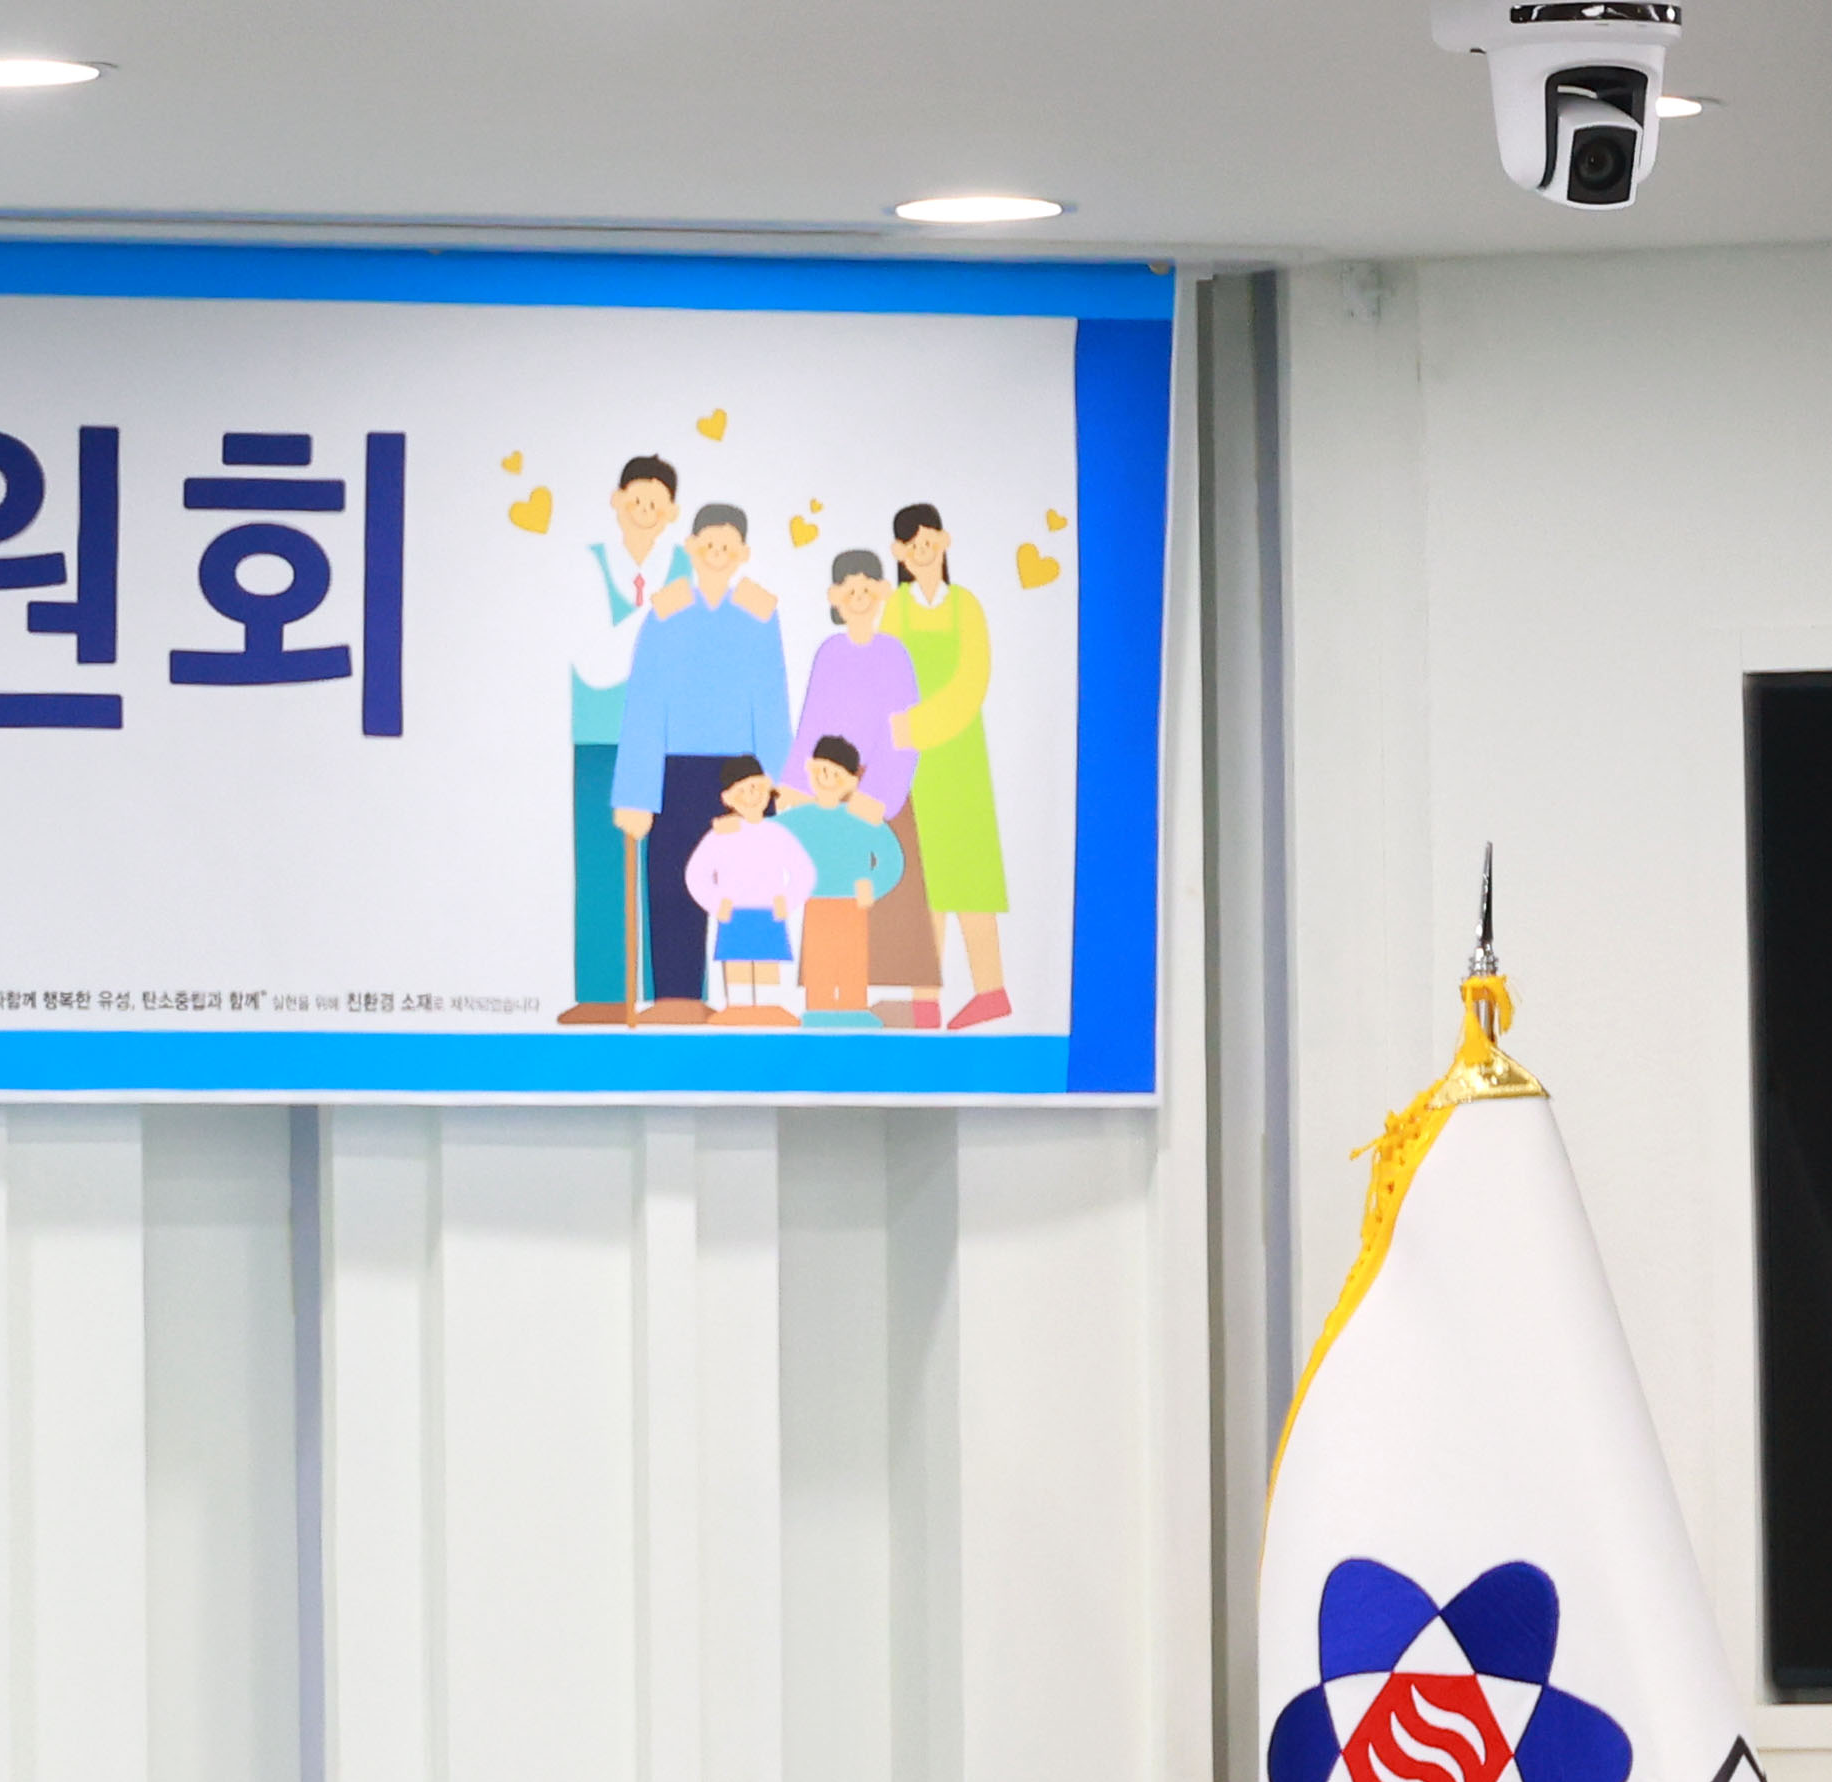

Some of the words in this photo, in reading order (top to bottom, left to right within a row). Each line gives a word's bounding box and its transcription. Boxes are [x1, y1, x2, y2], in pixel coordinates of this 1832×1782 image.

[42, 989, 92, 1010] 행복한
[141, 990, 223, 1011] 탄소중립과
[346, 991, 396, 1012] 친환경
